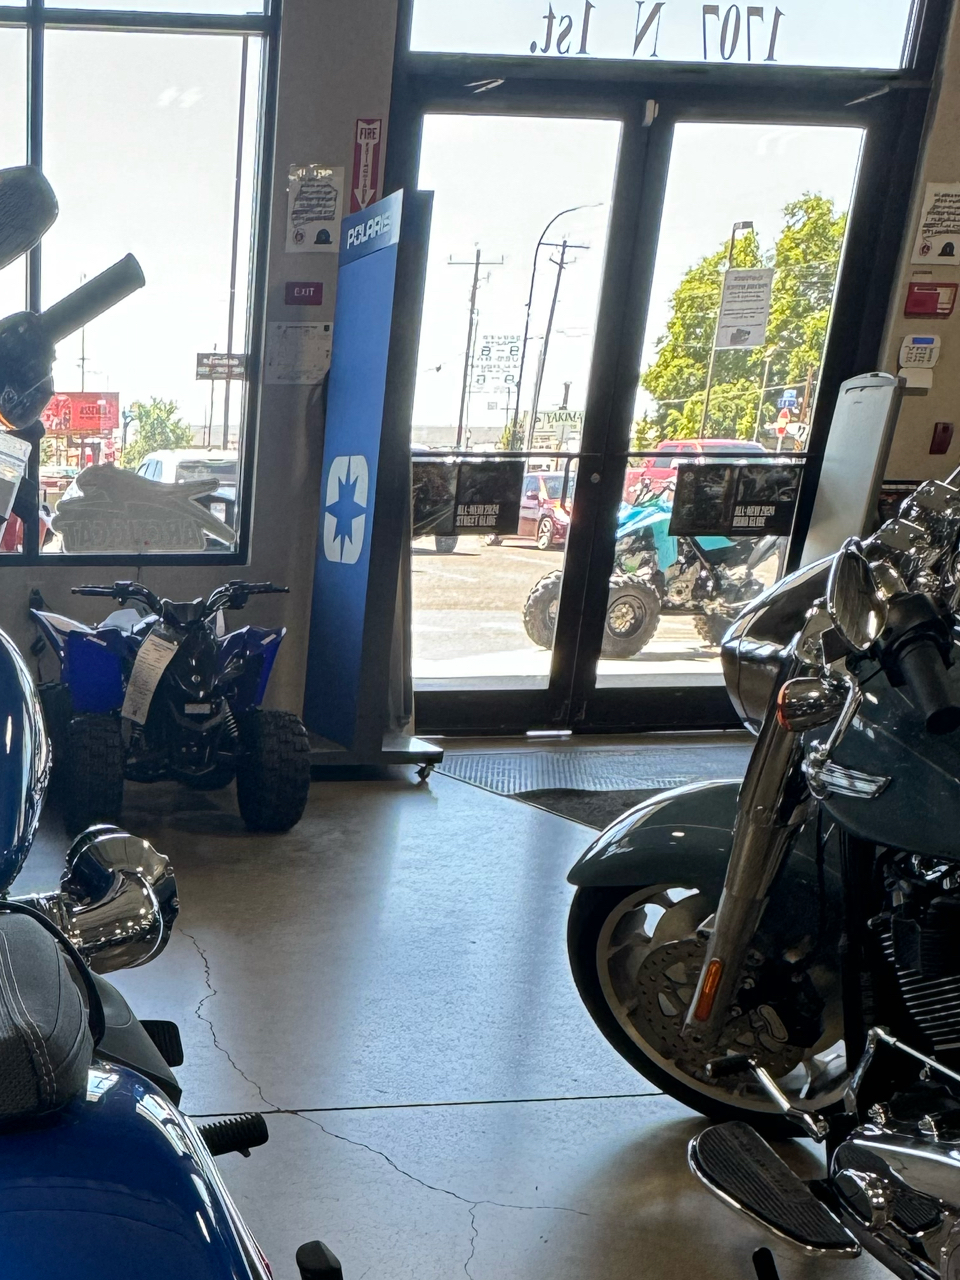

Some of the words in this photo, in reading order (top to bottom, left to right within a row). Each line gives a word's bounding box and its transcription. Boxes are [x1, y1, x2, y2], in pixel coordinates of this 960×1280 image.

[359, 127, 378, 140] FIRE
[346, 211, 392, 250] POLARIS
[294, 287, 315, 297] EXIT
